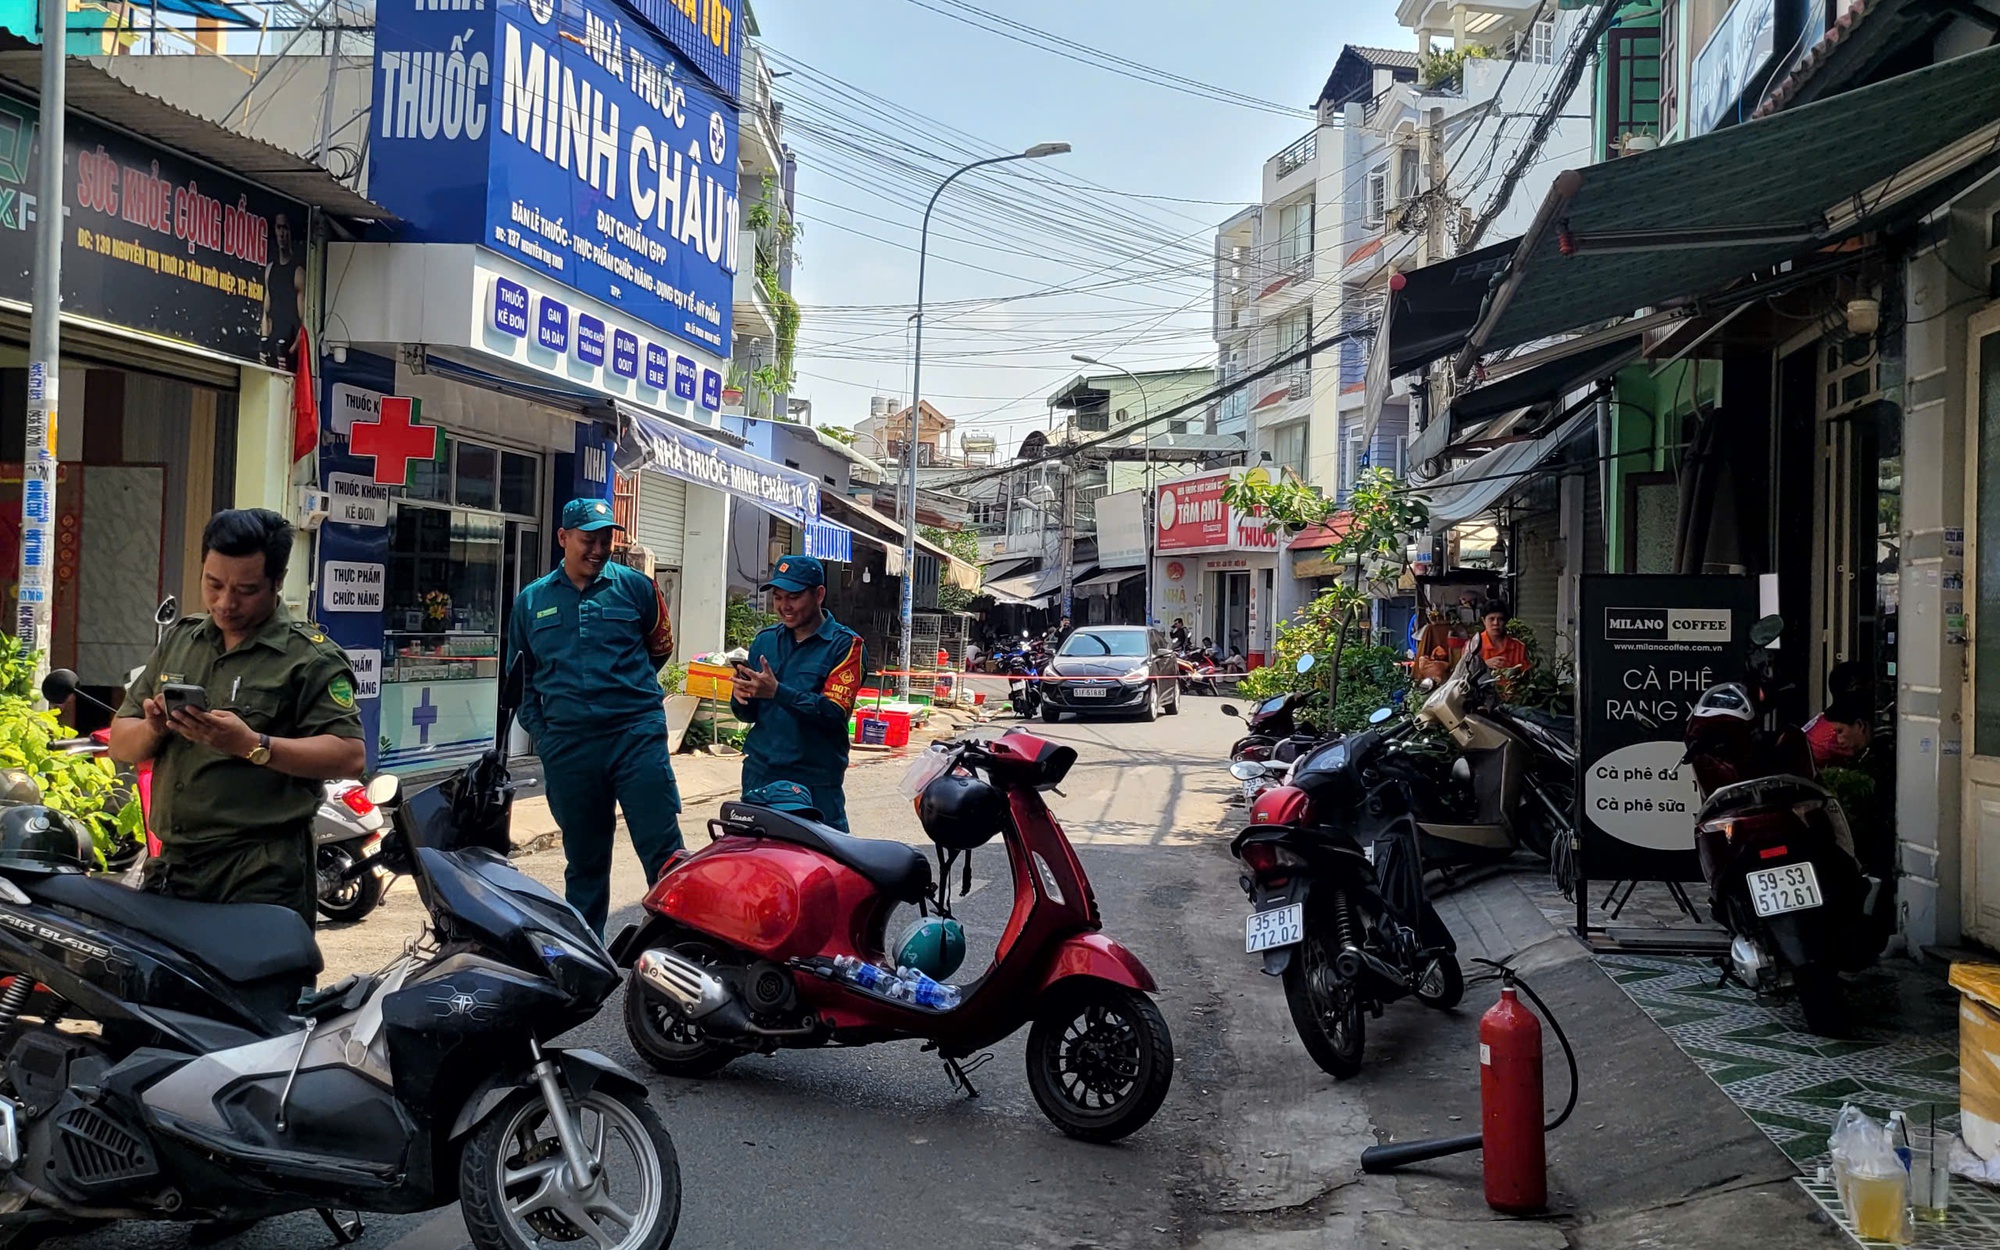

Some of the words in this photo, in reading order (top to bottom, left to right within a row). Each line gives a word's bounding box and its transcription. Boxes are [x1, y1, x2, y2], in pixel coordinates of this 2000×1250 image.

[585, 8, 624, 83] NHÀ
[629, 46, 686, 130] THUỐC
[381, 28, 489, 140] THUỐC
[501, 22, 620, 200] MINH
[629, 125, 725, 263] CHÂU
[726, 199, 740, 274] 10
[77, 144, 120, 217] SỨC
[121, 158, 172, 235] KHỎE
[174, 180, 222, 255] CỘNG
[507, 229, 520, 249] 137
[597, 208, 615, 239] ĐẠT
[616, 222, 648, 257] CHUẨN
[649, 240, 667, 266] GPP
[95, 234, 111, 256] 139
[112, 239, 145, 266] NGUYỄN
[146, 249, 159, 274] THỊ
[178, 262, 186, 278] P.
[187, 261, 201, 284] TÂN
[540, 217, 568, 248] THUỐC
[572, 234, 592, 263] THỰC
[592, 243, 614, 272] PHẨM
[614, 257, 633, 281] CHỨC
[634, 266, 653, 292] NĂNG
[704, 302, 720, 327] PHẨM
[500, 287, 525, 310] THUỐC
[497, 308, 508, 325] KÊ
[509, 313, 525, 332] ĐƠN
[547, 308, 562, 325] GAN
[541, 327, 551, 344] DẠ
[551, 329, 565, 347] DÀY
[345, 393, 372, 413] THUỐC
[583, 442, 607, 485] NHÀ
[652, 435, 684, 472] NHÀ
[685, 446, 729, 487] THUỐC
[730, 463, 760, 497] MINH
[760, 473, 790, 505] CHÂU
[791, 484, 803, 509] 10
[334, 477, 360, 497] THUỐC
[357, 506, 375, 521] ĐƠN
[1177, 496, 1200, 525] TÂM
[333, 568, 355, 586] THỰC
[356, 564, 381, 584] PHẨM
[332, 589, 355, 606] CHỨC
[357, 590, 380, 606] NĂNG
[1608, 618, 1664, 630] MILANO
[1671, 619, 1728, 631] COFFEE
[1613, 643, 1723, 652] www.milanocoffee.com.vn
[1623, 664, 1662, 691] CÀ
[1669, 665, 1713, 691] PHÊ
[1606, 699, 1678, 721] RANG
[1596, 766, 1619, 780] Cà
[1624, 766, 1653, 782] phê
[1596, 797, 1619, 811] Cà
[1624, 798, 1653, 814] phê
[1658, 799, 1686, 813] sữa
[1757, 867, 1806, 892] 59-S3
[1759, 885, 1816, 912] 512.61
[1255, 907, 1293, 932] 35-B1
[1250, 924, 1299, 951] 712.02
